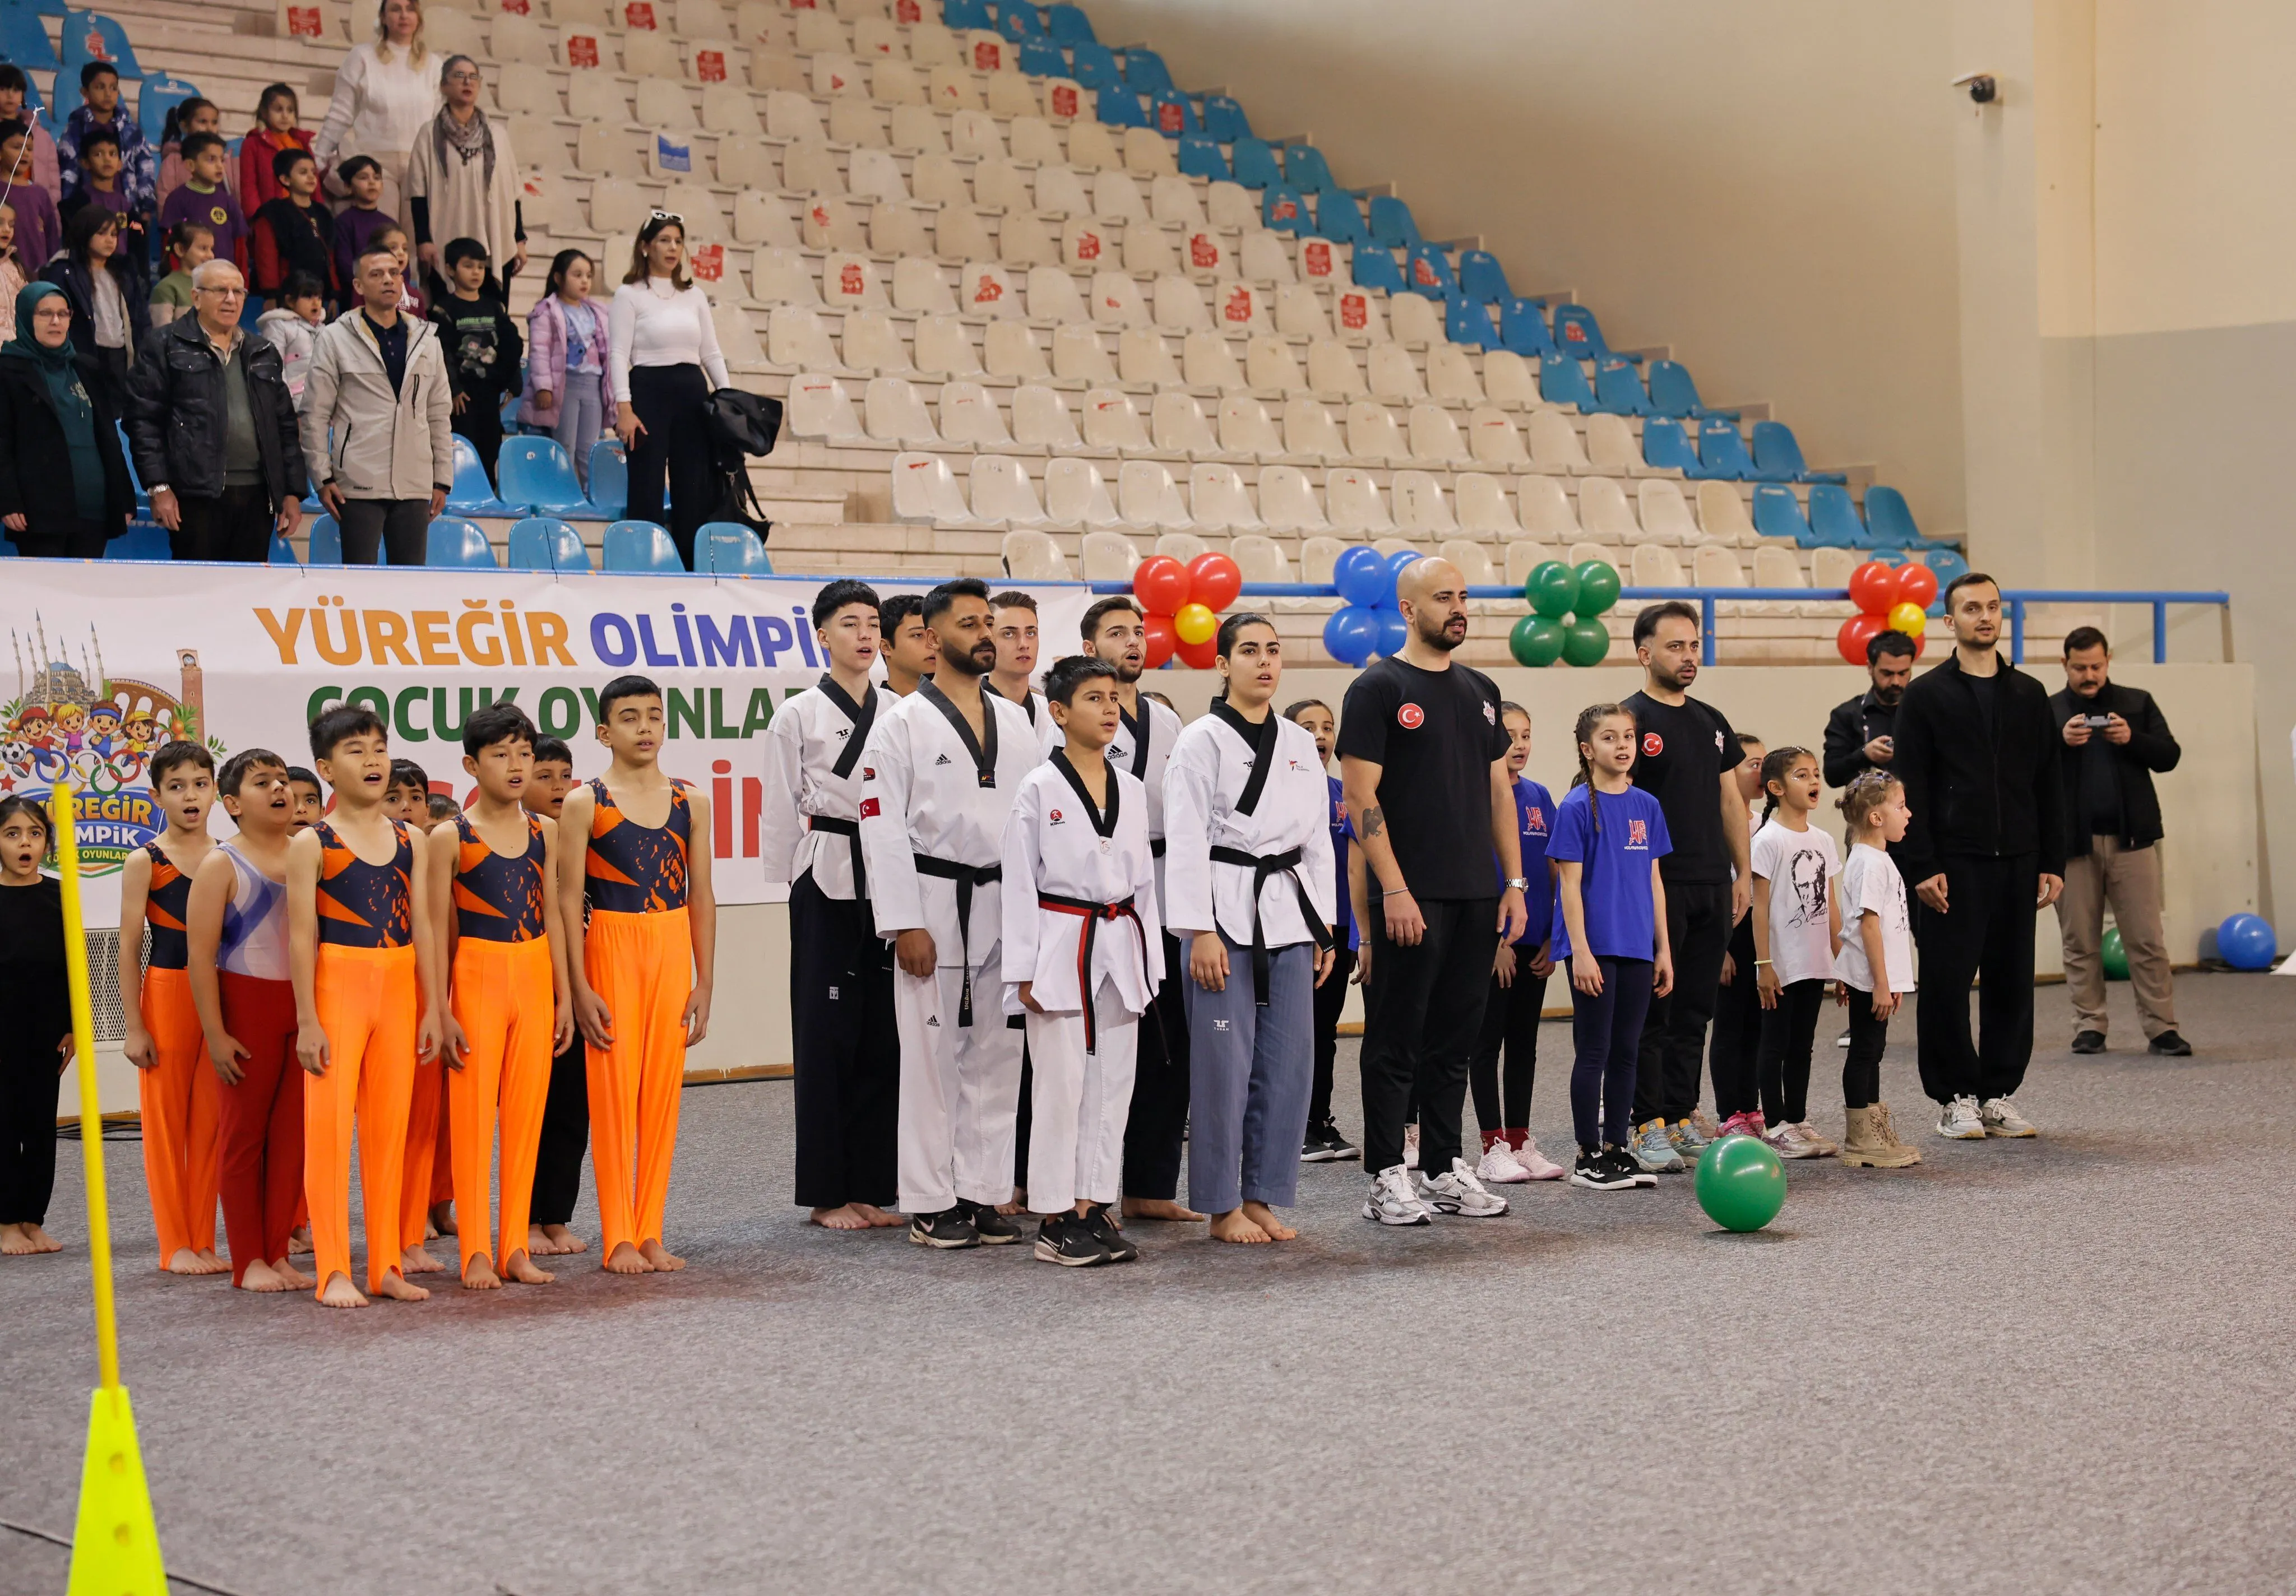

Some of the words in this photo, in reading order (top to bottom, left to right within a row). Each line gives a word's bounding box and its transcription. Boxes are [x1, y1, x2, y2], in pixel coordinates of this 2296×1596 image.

[252, 595, 578, 666] YÜREĞİR
[590, 602, 831, 668] OLİMPİ
[538, 686, 813, 741] OYNLA
[1107, 751, 1128, 760] adidas
[38, 794, 152, 826] REĞİR
[55, 824, 141, 848] MPİK
[82, 850, 129, 860] OYUNLAR
